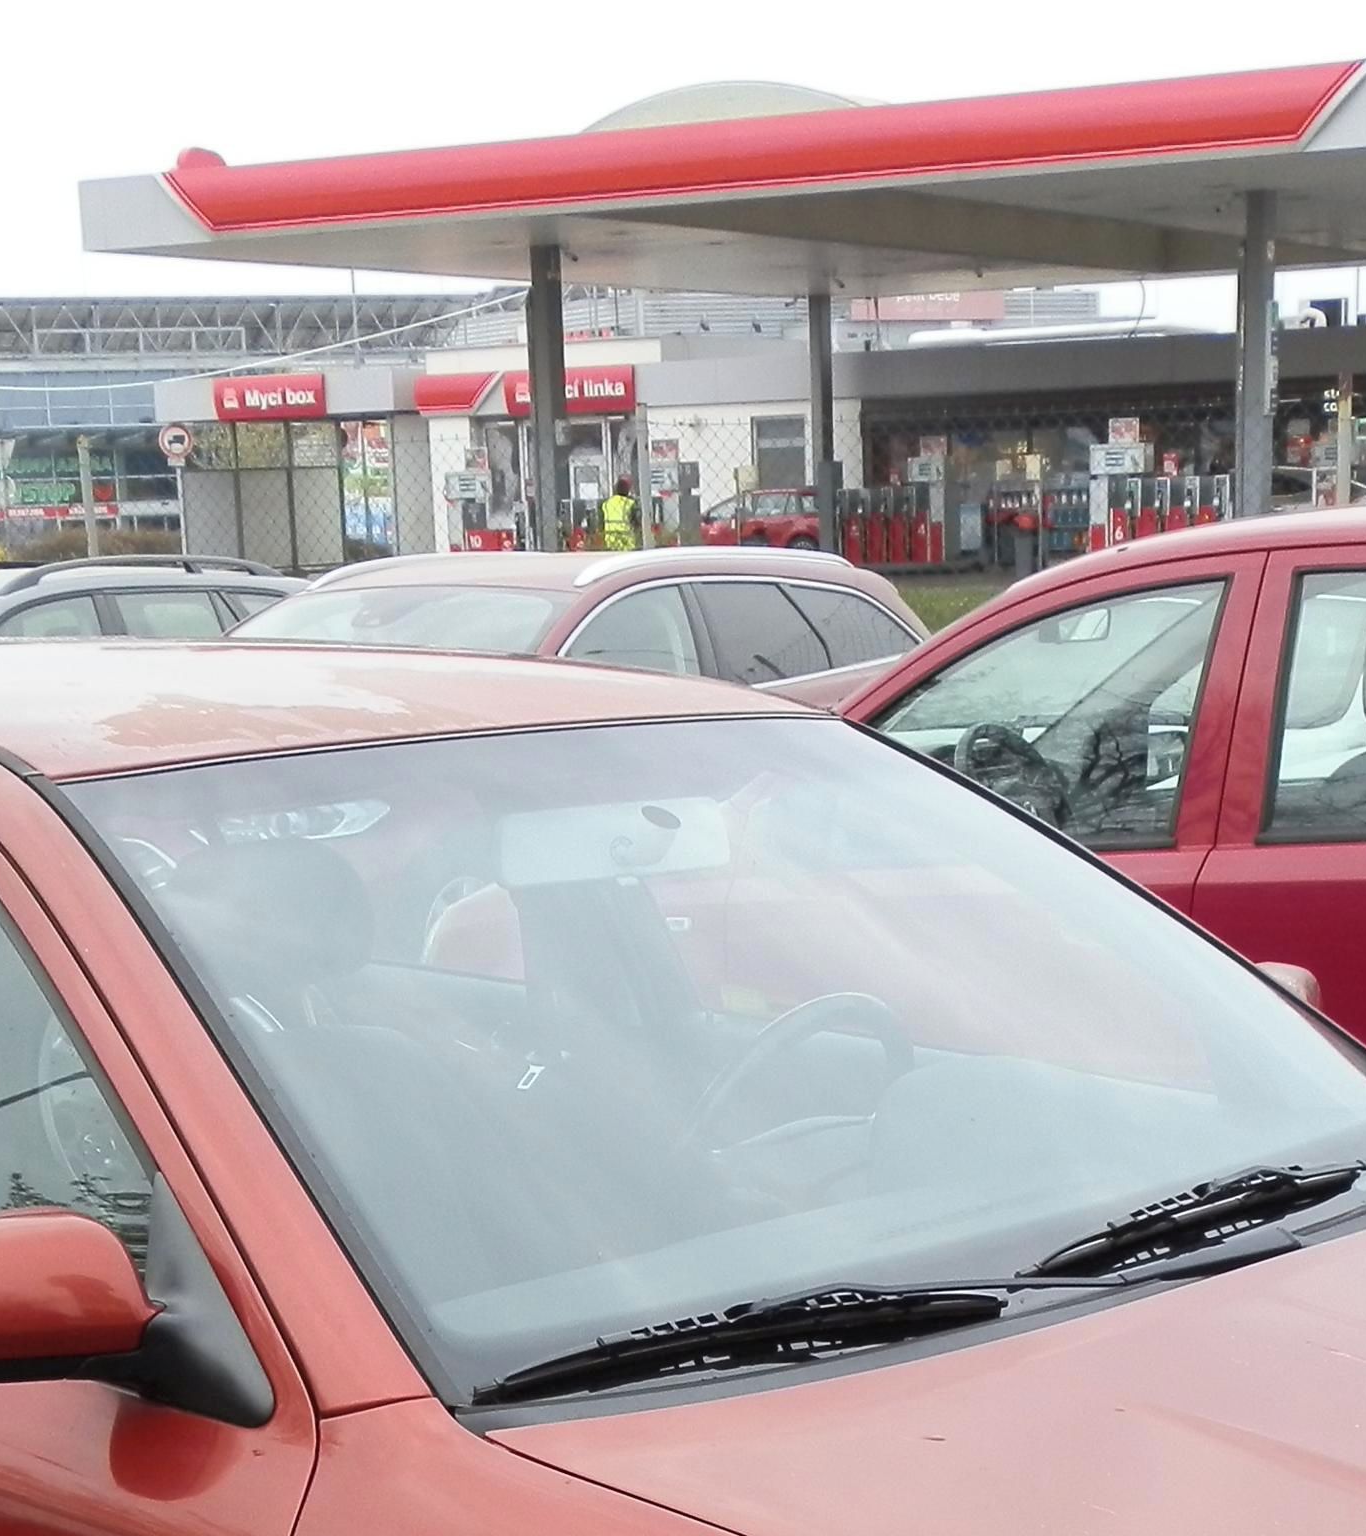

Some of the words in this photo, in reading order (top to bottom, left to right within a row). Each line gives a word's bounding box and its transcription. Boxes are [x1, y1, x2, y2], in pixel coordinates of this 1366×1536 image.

[244, 387, 283, 410] Mycí
[285, 385, 316, 405] box
[565, 380, 579, 399] cí
[583, 378, 625, 398] linka
[469, 534, 482, 546] 10
[1114, 526, 1124, 541] 6
